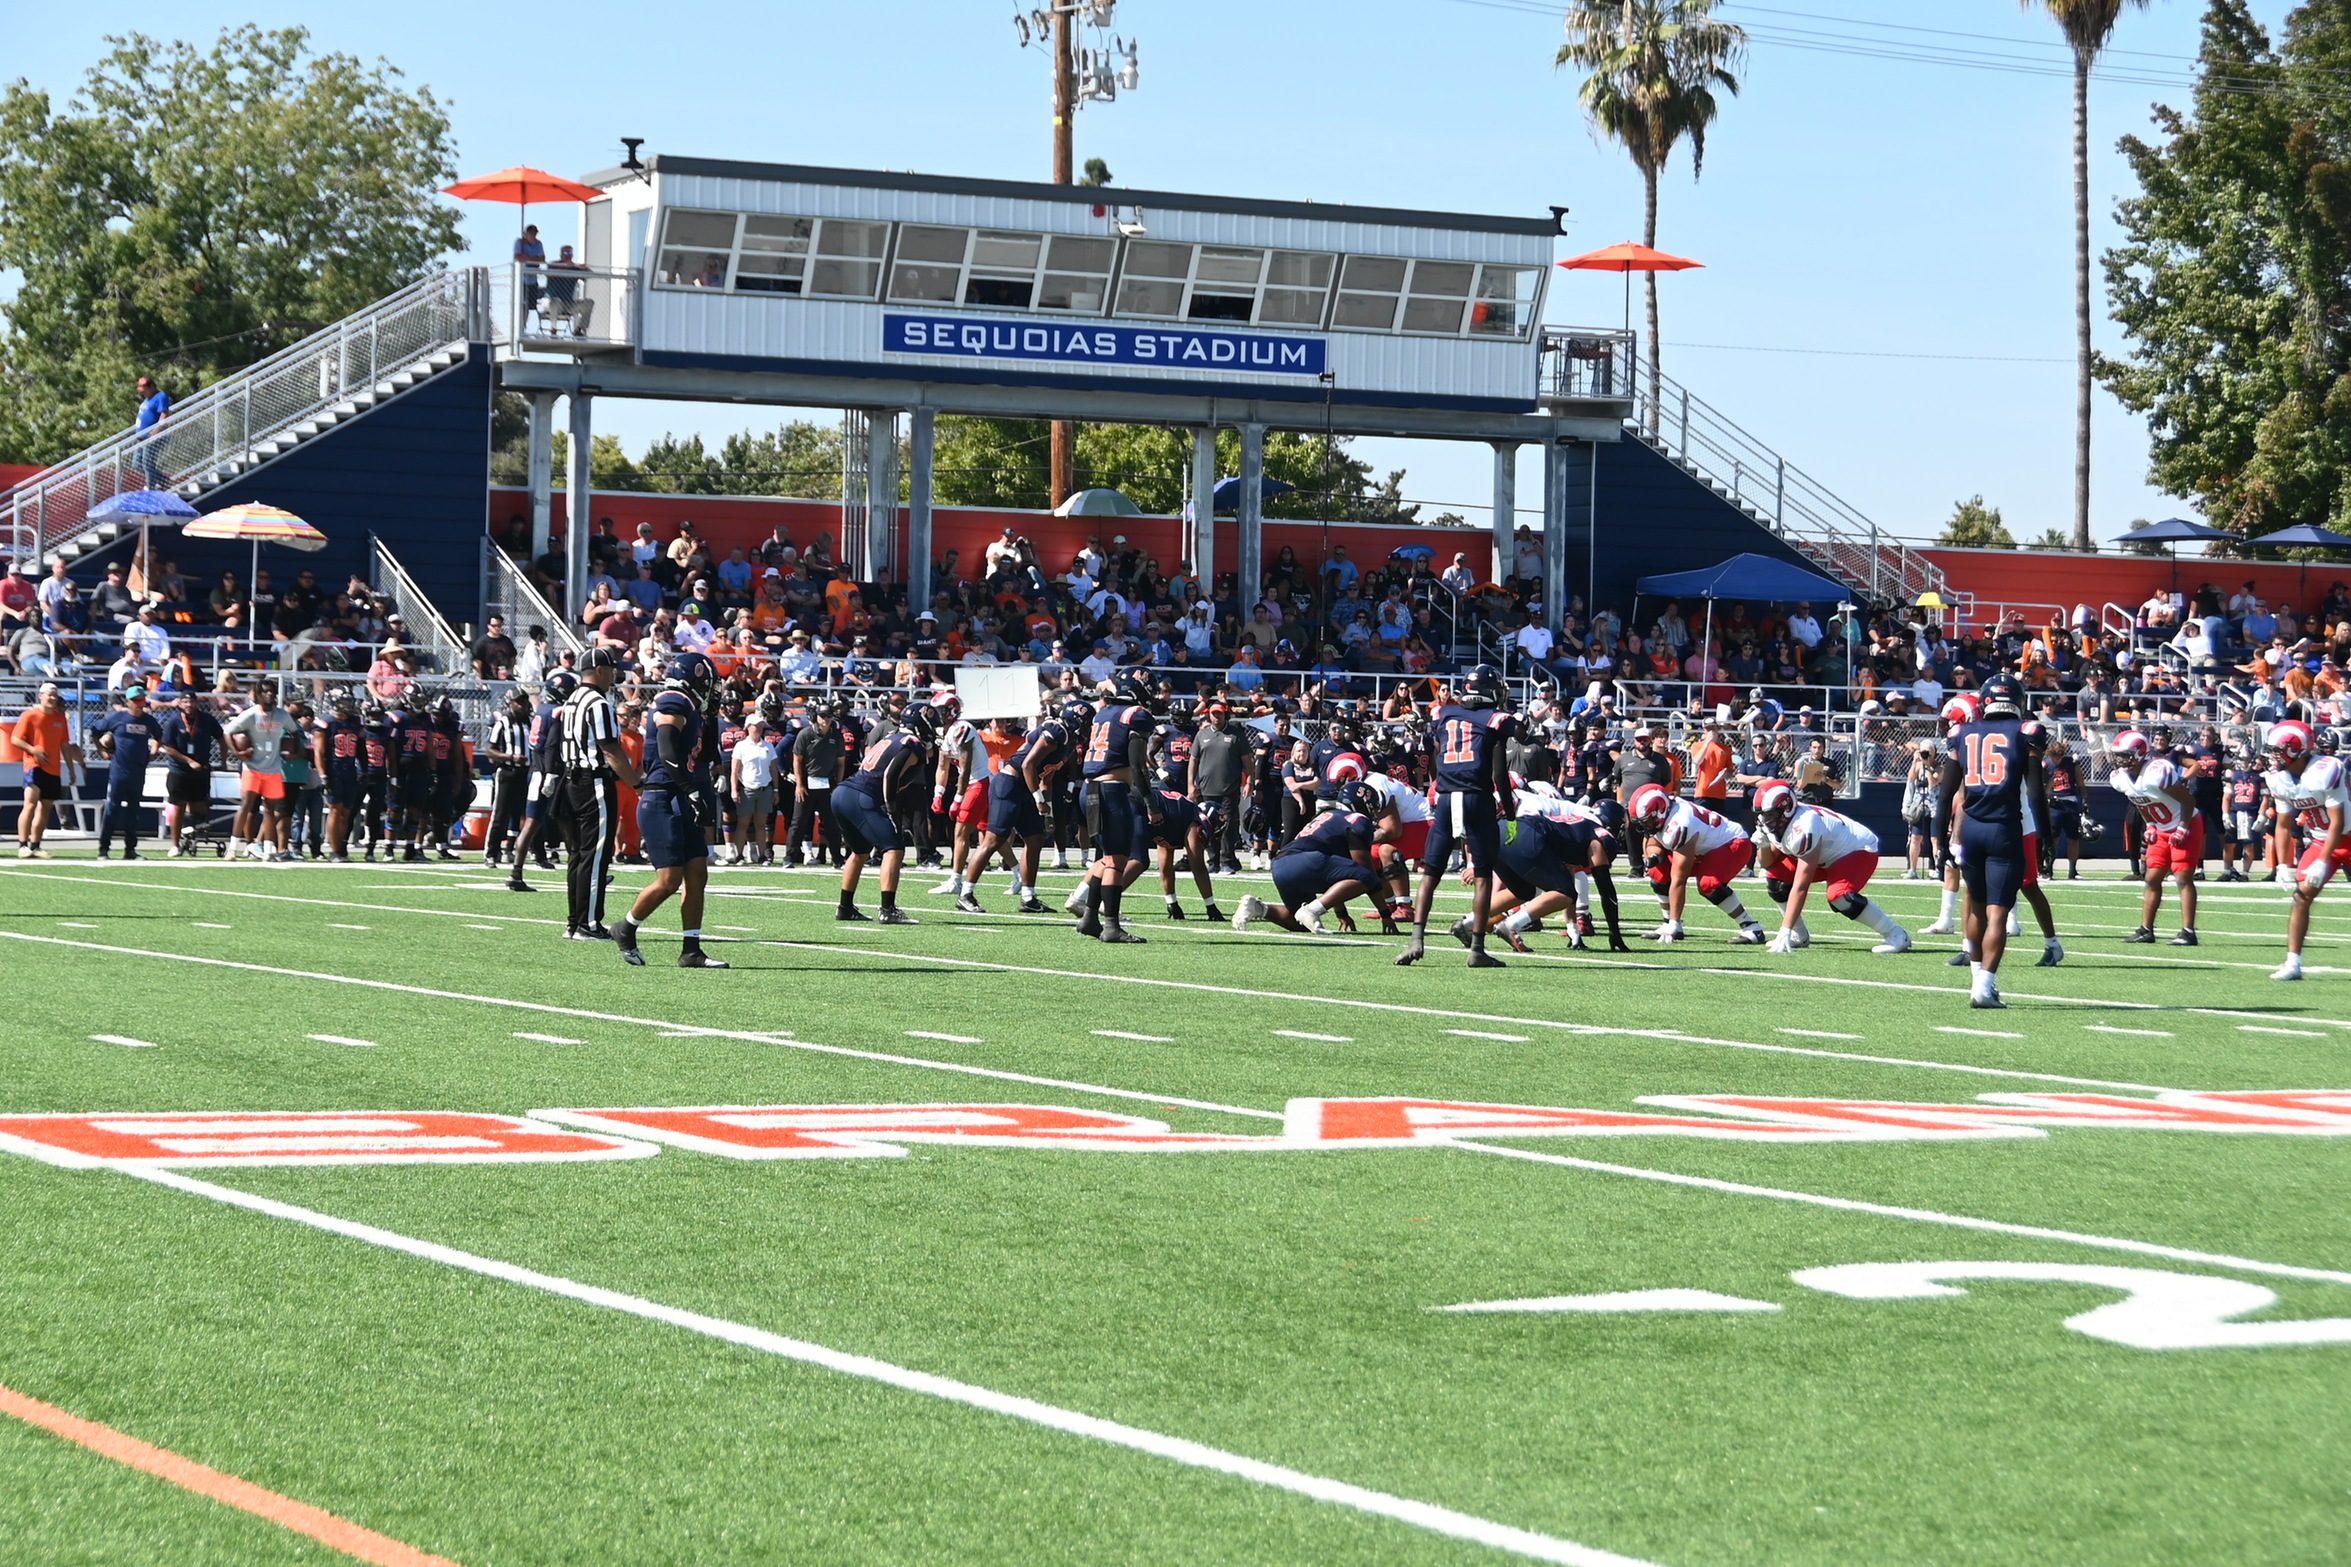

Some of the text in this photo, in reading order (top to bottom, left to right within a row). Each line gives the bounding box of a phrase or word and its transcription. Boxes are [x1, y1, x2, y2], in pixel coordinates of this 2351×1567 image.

[903, 321, 1308, 368] SEQUOIAS STADIUM
[403, 729, 427, 752] 75
[1443, 718, 1475, 765] 11
[1964, 732, 2009, 787] 16
[2233, 782, 2255, 803] 23
[1790, 1258, 2351, 1351] 2
